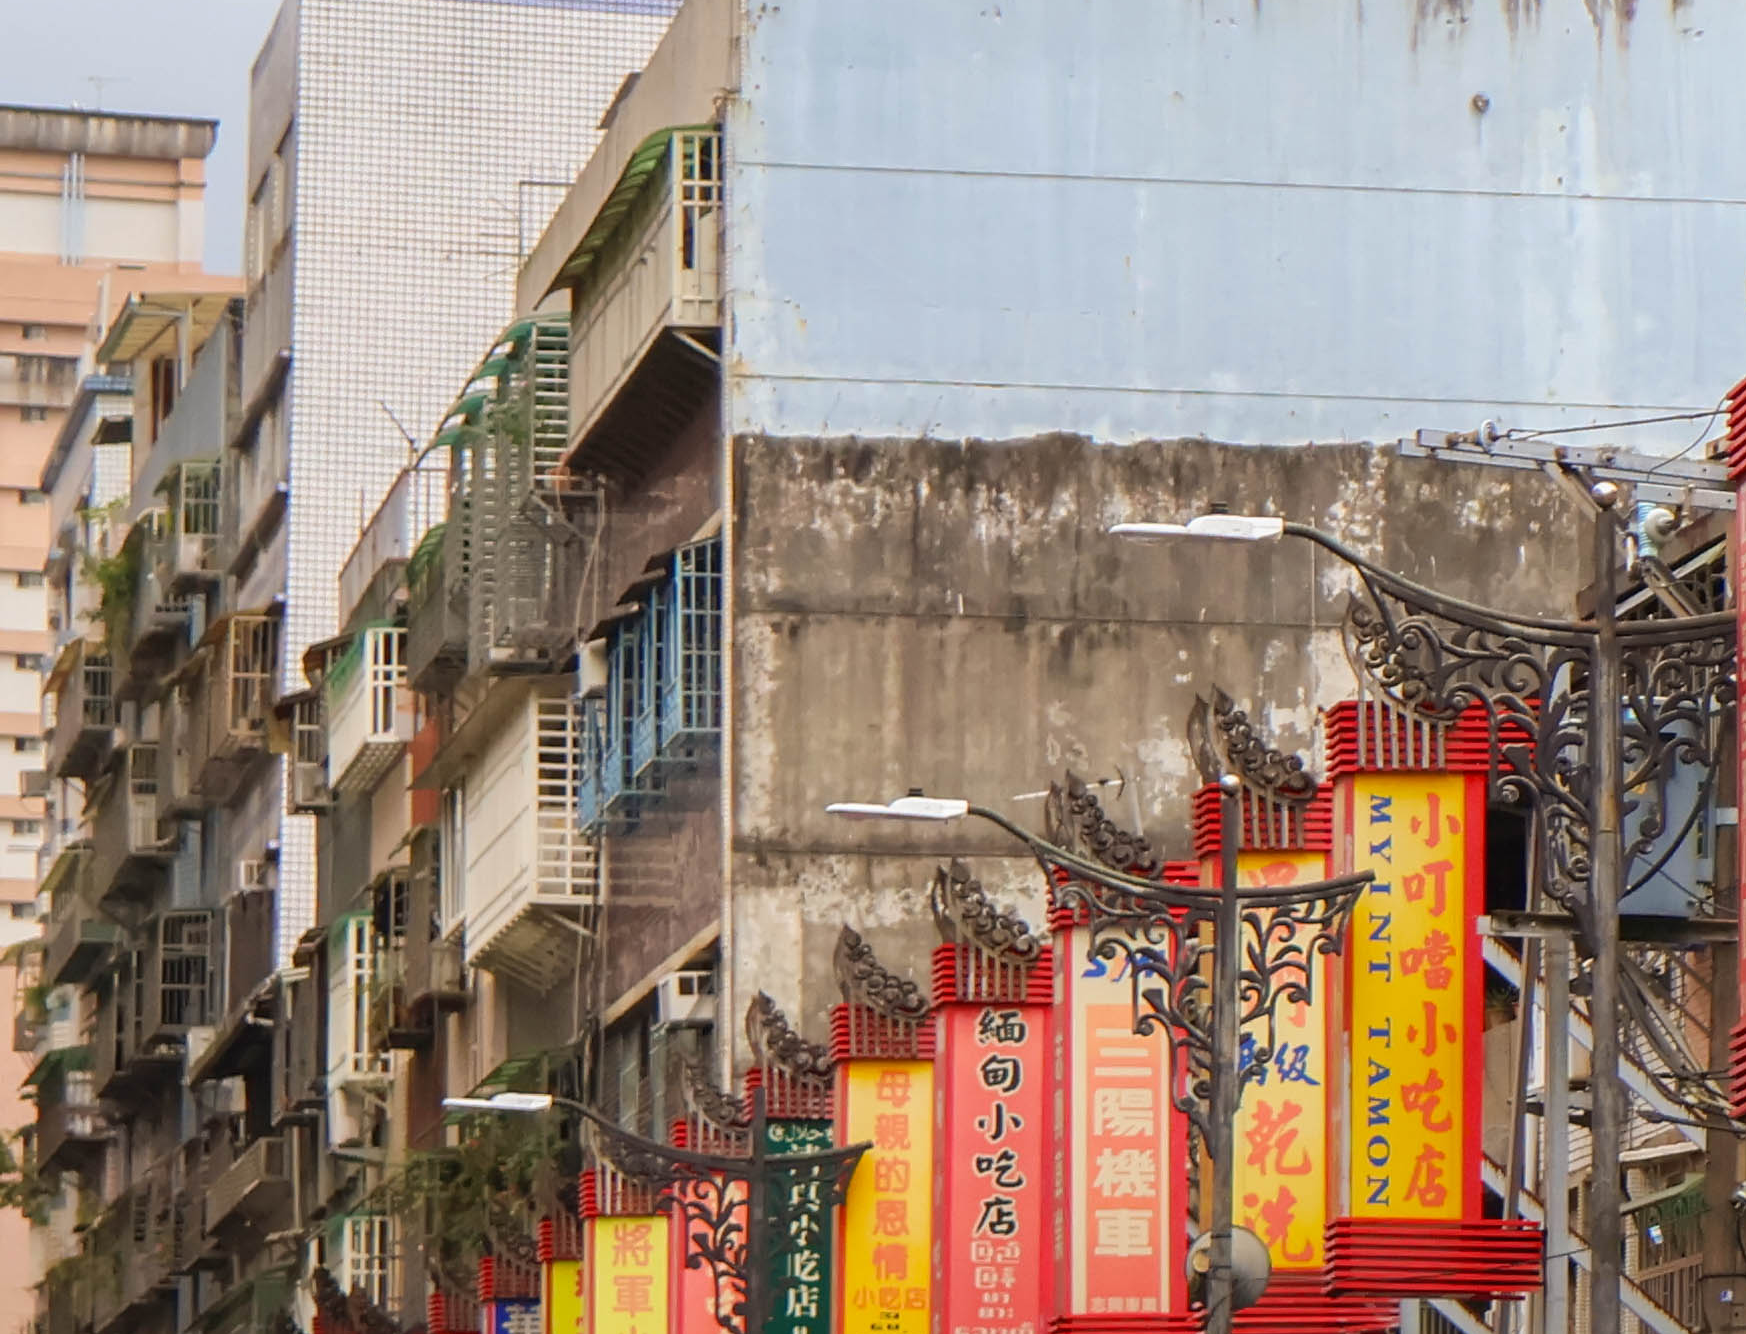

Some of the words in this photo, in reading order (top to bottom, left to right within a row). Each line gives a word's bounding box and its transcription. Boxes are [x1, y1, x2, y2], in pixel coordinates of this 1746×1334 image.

[1368, 794, 1393, 983] MYINT
[1400, 792, 1462, 1208] 小叮噹小吃店
[873, 1070, 912, 1282] 母親的恩情
[973, 1007, 1028, 1238] 緬甸小吃店
[1093, 1027, 1159, 1258] 三陽機車
[1367, 1023, 1393, 1207] TAMON
